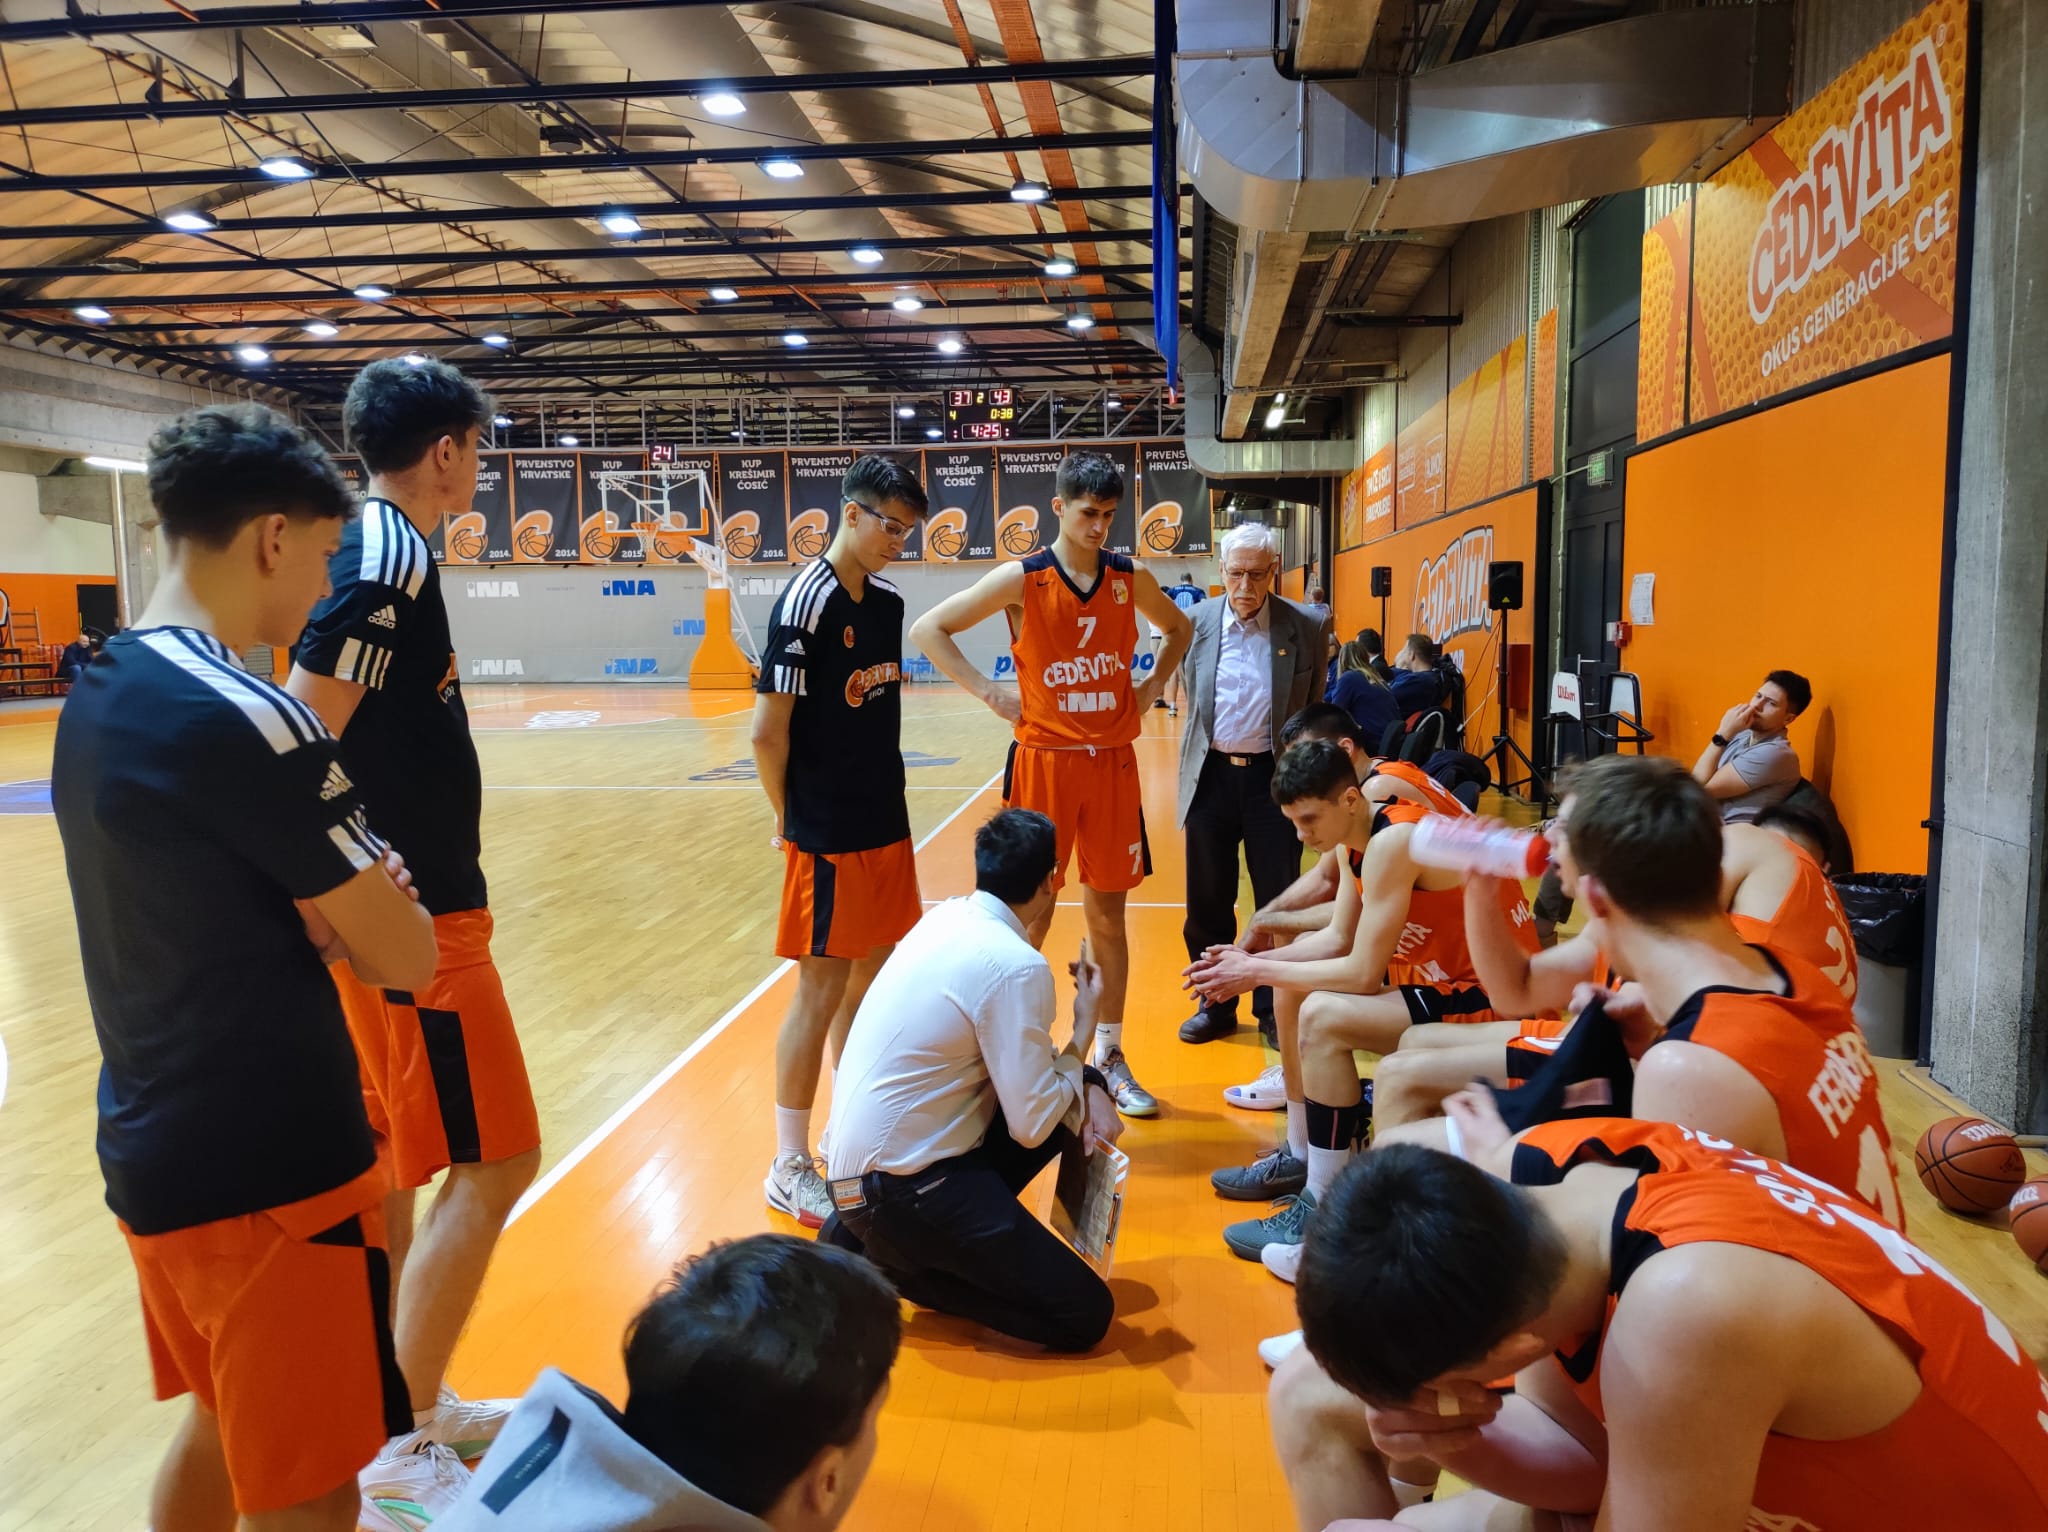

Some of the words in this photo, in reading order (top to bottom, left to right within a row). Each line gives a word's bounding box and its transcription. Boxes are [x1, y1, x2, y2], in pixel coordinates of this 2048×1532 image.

[1748, 35, 1952, 325] CEDEVITA
[1760, 330, 1801, 378] OKUS
[1803, 234, 1911, 344] GENERACIJE
[1913, 191, 1951, 253] CE
[954, 391, 971, 405] 37
[993, 390, 1010, 403] 43
[990, 408, 1013, 419] 0:38
[971, 425, 999, 437] 4:25
[652, 445, 671, 460] 24
[1000, 452, 1062, 462] PRVENSTVO
[1145, 450, 1186, 460] PRVENS
[515, 459, 575, 468] PRVENSTVO
[602, 460, 623, 469] KUP
[741, 459, 762, 468] KUP
[791, 457, 851, 466] PRVENSTVO
[948, 455, 970, 464] KUP
[796, 468, 847, 477] HRVATSKE
[1004, 463, 1057, 474] HRVATSKE
[520, 470, 571, 479] HRVATSKE
[489, 550, 511, 559] 2014.
[555, 549, 579, 557] 2014.
[969, 547, 992, 555] 2017.
[1077, 616, 1097, 648] 7
[1043, 651, 1126, 687] CEDEVITA
[1128, 841, 1142, 875] 7
